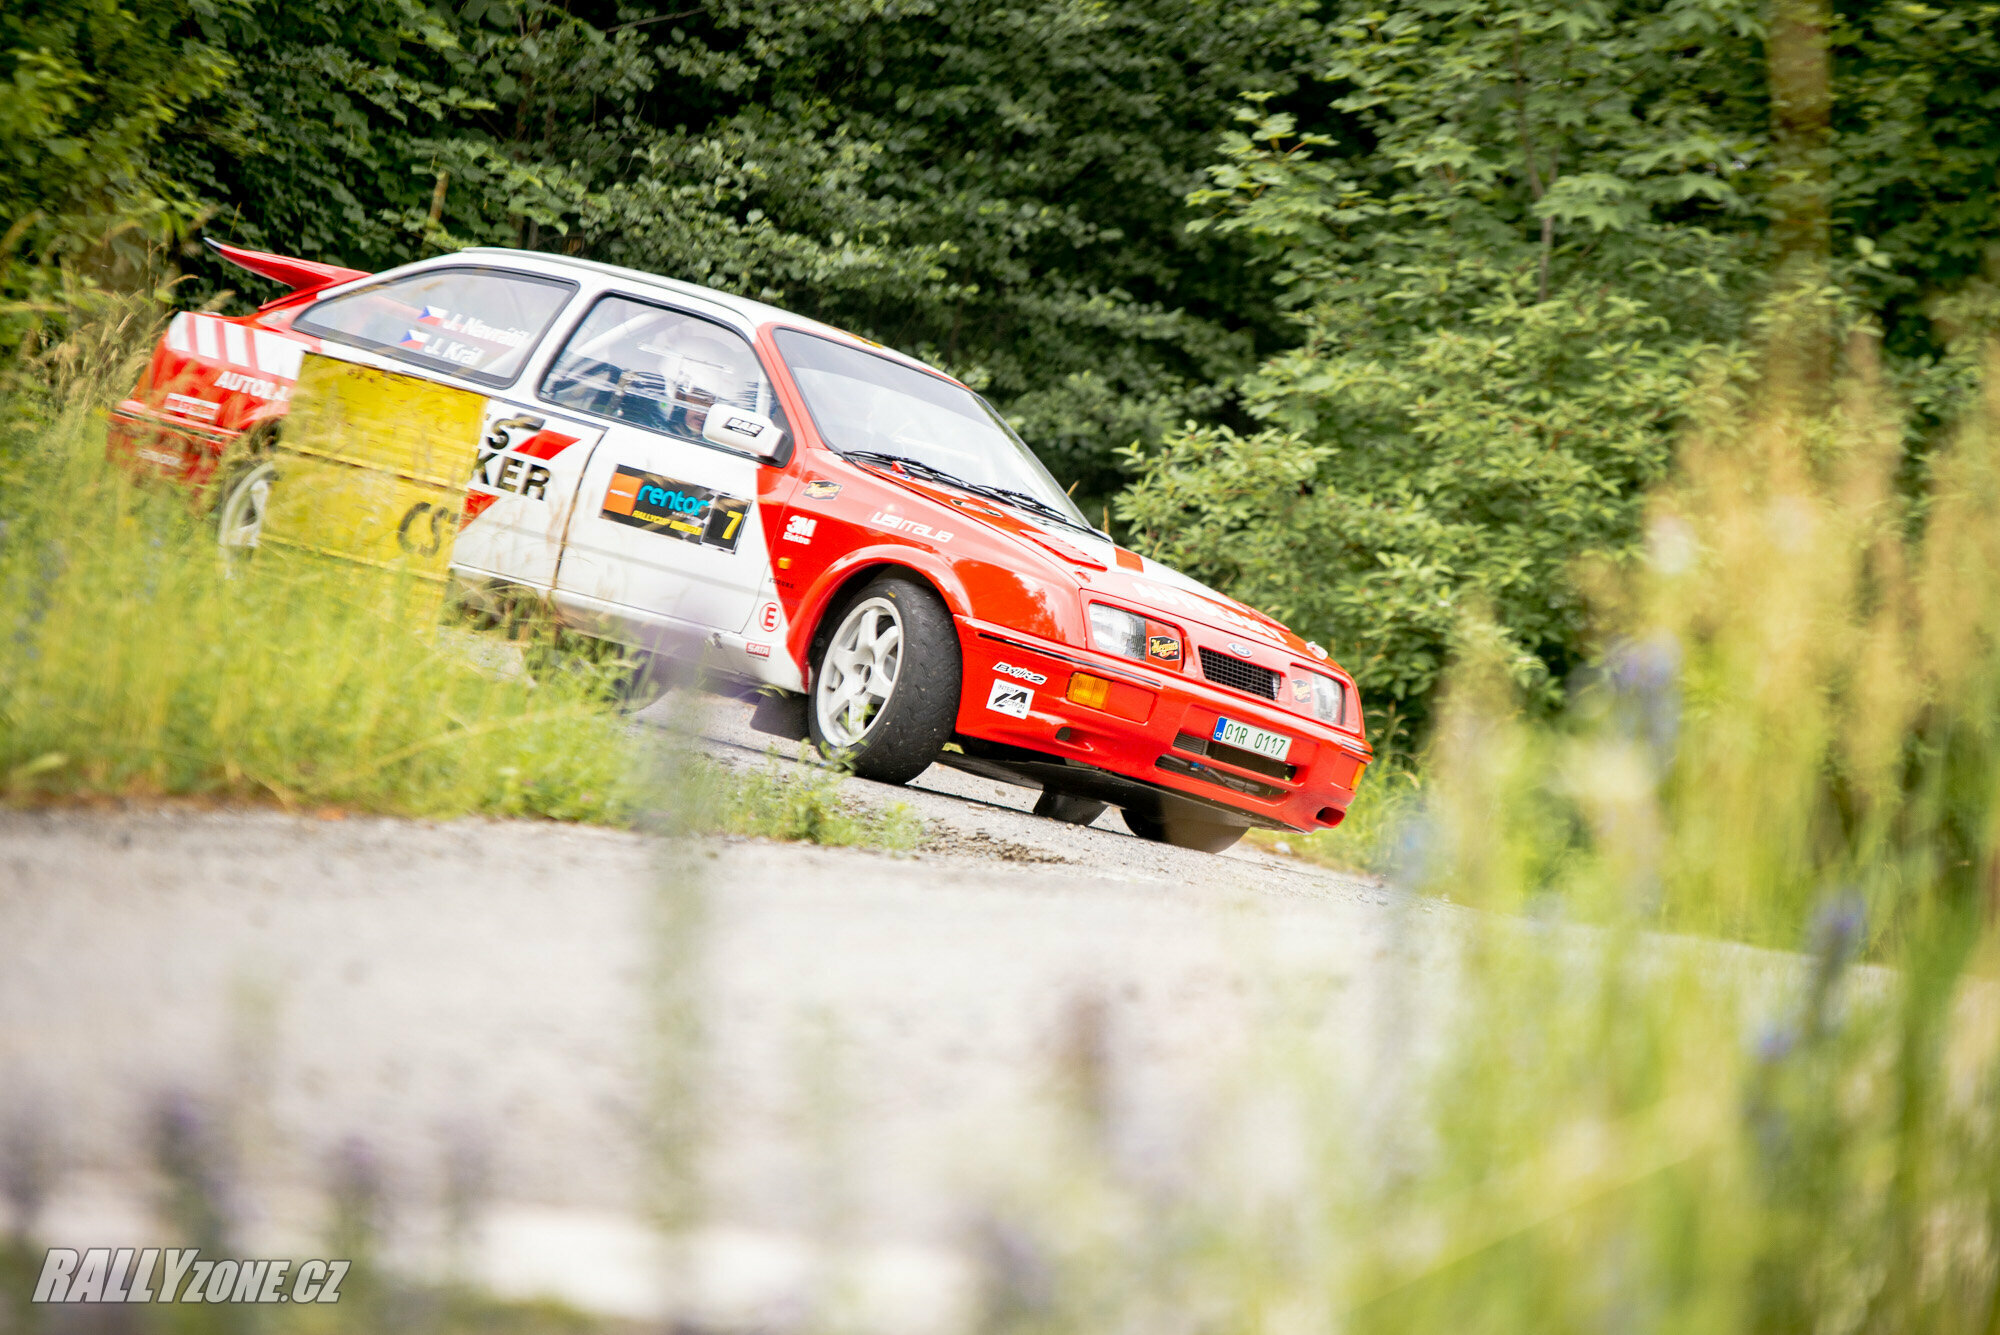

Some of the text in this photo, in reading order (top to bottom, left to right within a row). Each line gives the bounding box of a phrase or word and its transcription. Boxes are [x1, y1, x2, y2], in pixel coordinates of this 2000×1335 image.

[442, 313, 463, 331] J.
[424, 337, 444, 355] J.
[637, 484, 710, 517] rentor
[722, 510, 744, 540] 7
[786, 515, 818, 538] 3M
[764, 607, 777, 627] E
[1225, 723, 1287, 756] 01R 0117
